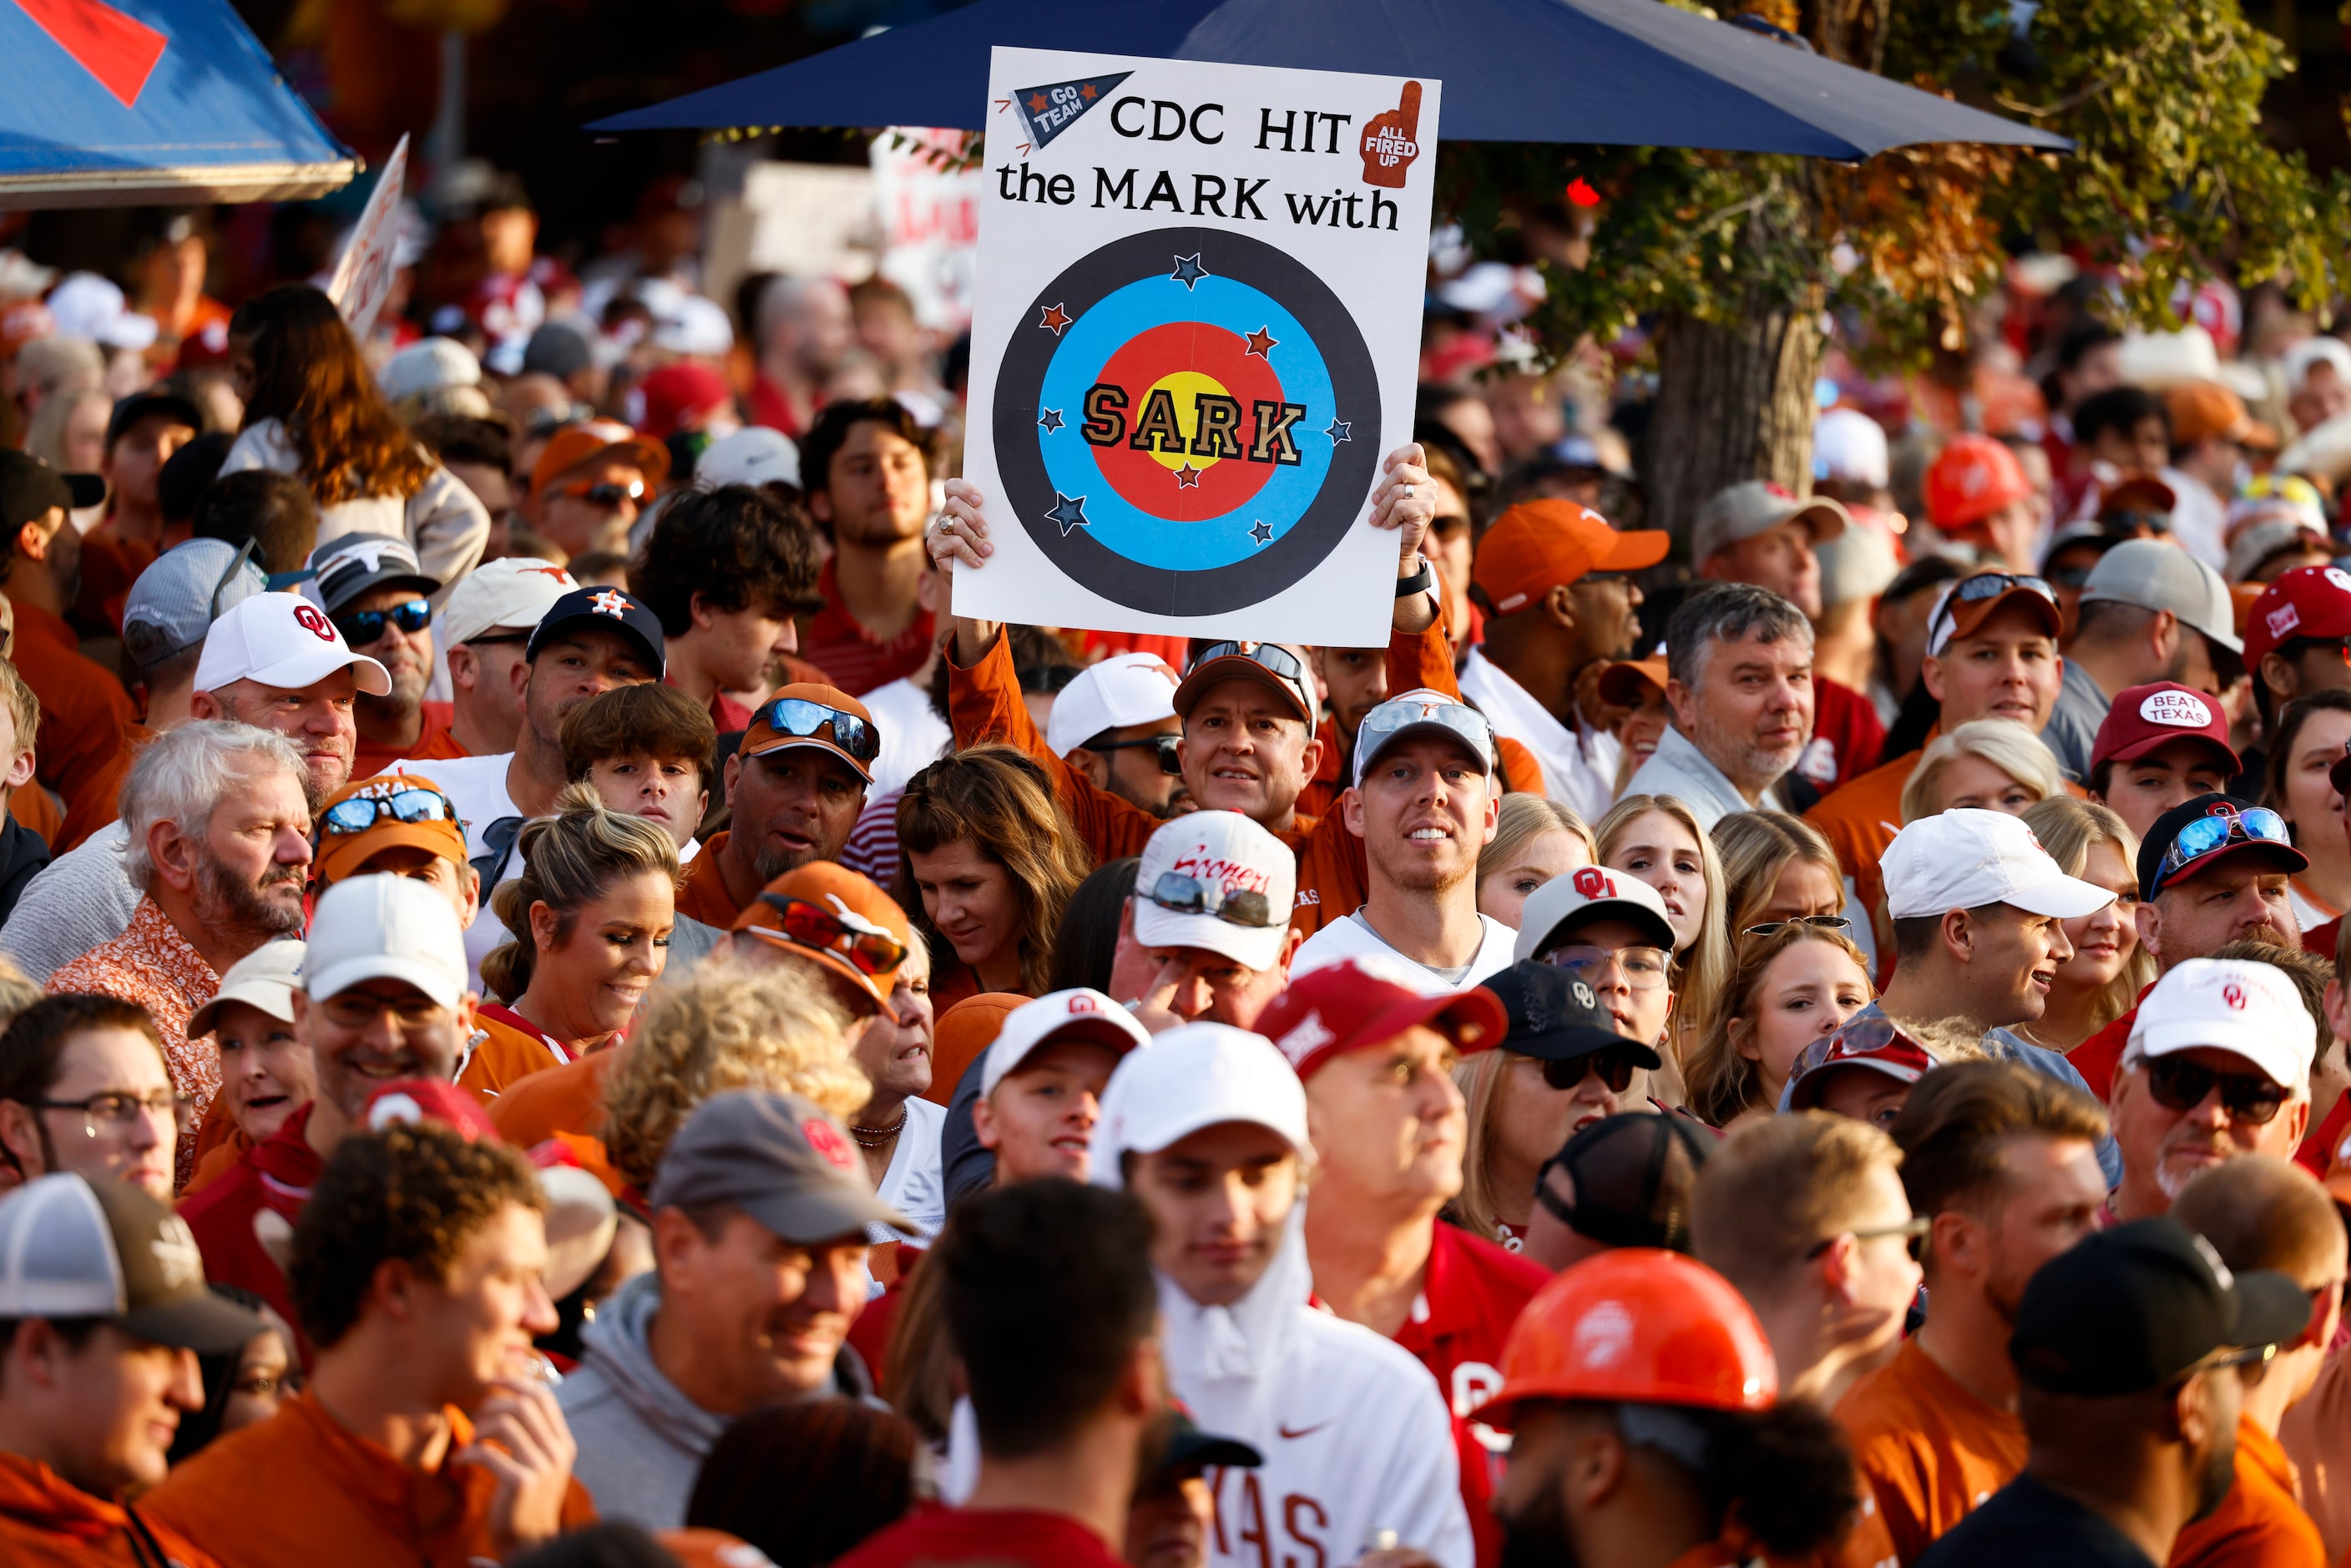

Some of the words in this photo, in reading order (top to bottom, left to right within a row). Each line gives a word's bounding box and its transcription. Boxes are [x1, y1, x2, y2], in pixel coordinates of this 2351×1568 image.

[1051, 86, 1077, 104] GO
[1034, 99, 1083, 133] TEAM
[1110, 96, 1224, 145] CDC
[1254, 108, 1352, 154] HIT
[1378, 125, 1406, 140] ALL
[1365, 136, 1417, 157] FIRED
[1379, 154, 1399, 168] UP
[996, 162, 1075, 205] the
[1090, 167, 1271, 220] MARK
[1284, 190, 1398, 231] with
[1080, 383, 1307, 466] SARK
[293, 605, 336, 642] OU
[2154, 695, 2197, 709] BEAT
[2150, 709, 2205, 725] TEXAS
[348, 781, 419, 799] EXA
[1573, 867, 1617, 900] OU
[1293, 889, 1328, 909] AS
[1572, 981, 1595, 1009] OU
[2223, 984, 2246, 1010] OU
